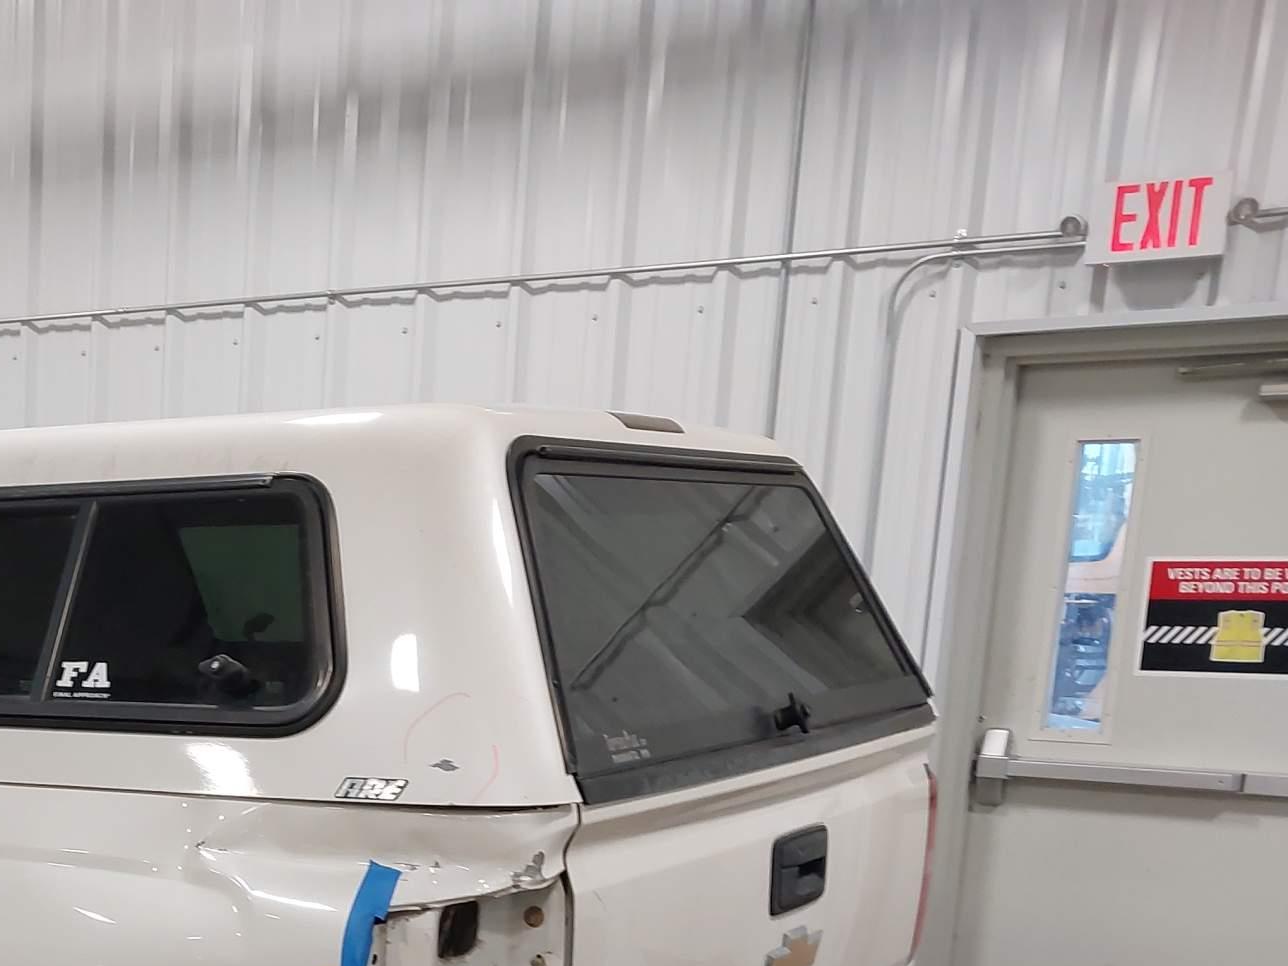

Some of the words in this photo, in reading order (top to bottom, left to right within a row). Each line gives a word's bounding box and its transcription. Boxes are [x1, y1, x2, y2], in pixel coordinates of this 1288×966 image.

[1111, 176, 1214, 252] EXIT
[1167, 568, 1211, 580] VESTS
[1212, 568, 1240, 580] ARE
[1242, 568, 1261, 580] TO
[1263, 568, 1283, 580] BE
[1178, 582, 1234, 593] BEYOND
[1237, 582, 1269, 594] THIS
[56, 661, 111, 688] FA
